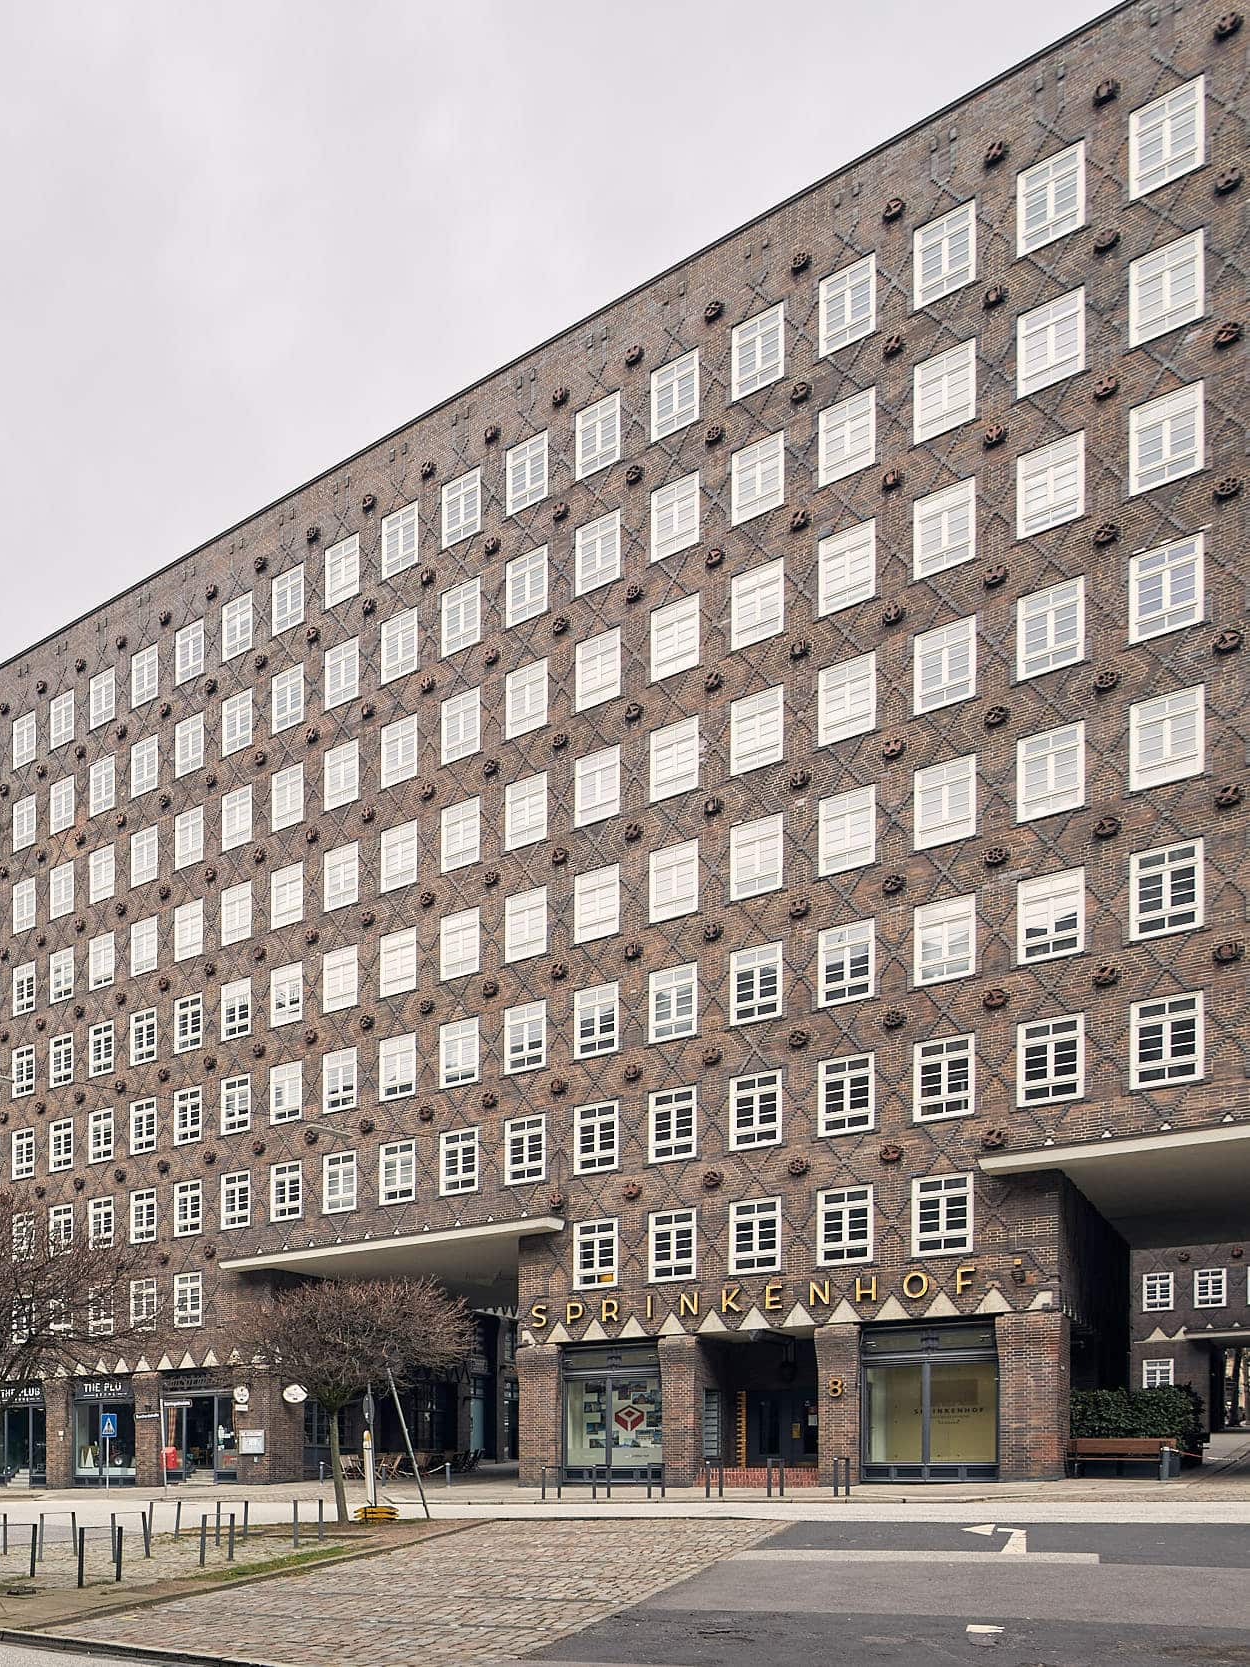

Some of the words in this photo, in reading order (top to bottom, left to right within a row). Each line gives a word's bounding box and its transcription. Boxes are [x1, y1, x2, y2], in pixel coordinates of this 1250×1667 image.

[531, 1265, 976, 1328] SPRINKENHOF
[828, 1377, 843, 1397] 8
[912, 1407, 984, 1416] SINKENHOF
